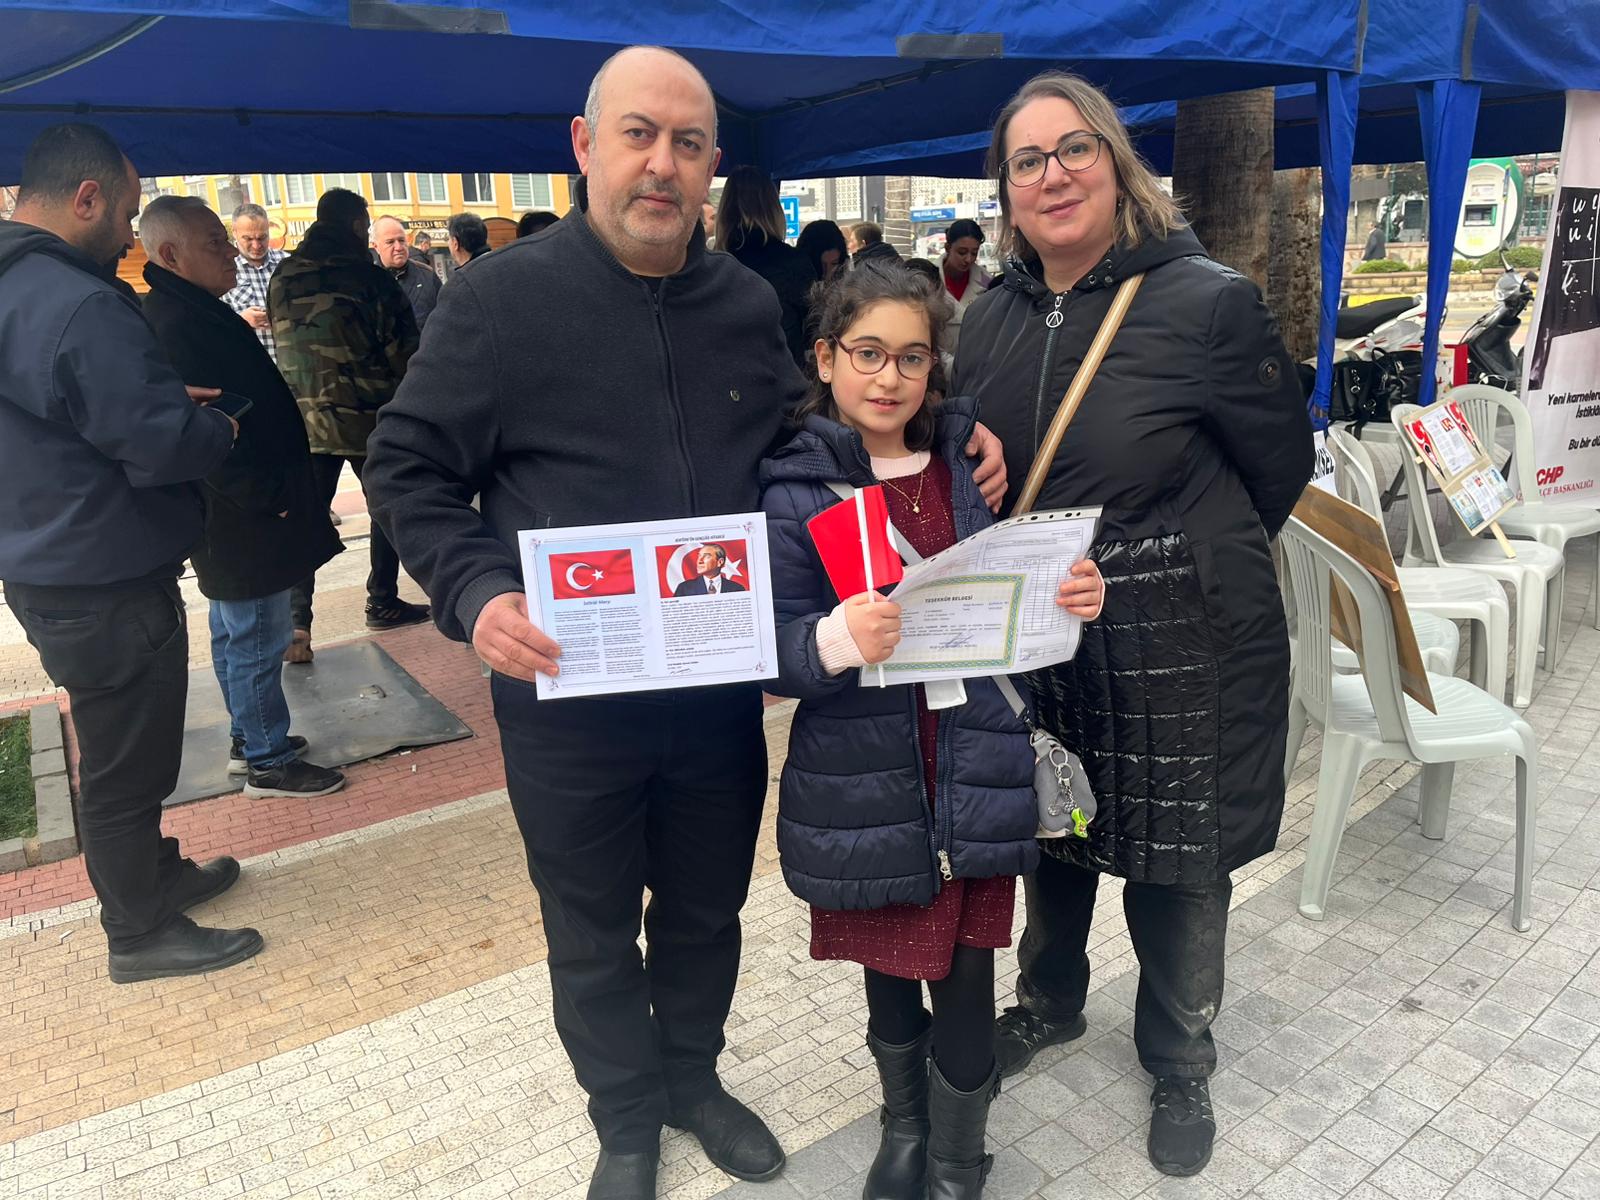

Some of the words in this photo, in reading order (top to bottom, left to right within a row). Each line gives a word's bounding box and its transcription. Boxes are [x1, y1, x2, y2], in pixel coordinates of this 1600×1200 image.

[1547, 392, 1567, 406] Yeni
[1568, 438, 1579, 451] Bu
[1579, 437, 1591, 449] bir
[1536, 465, 1564, 486] CHP
[1553, 479, 1594, 494] BAŞKANLIĞI
